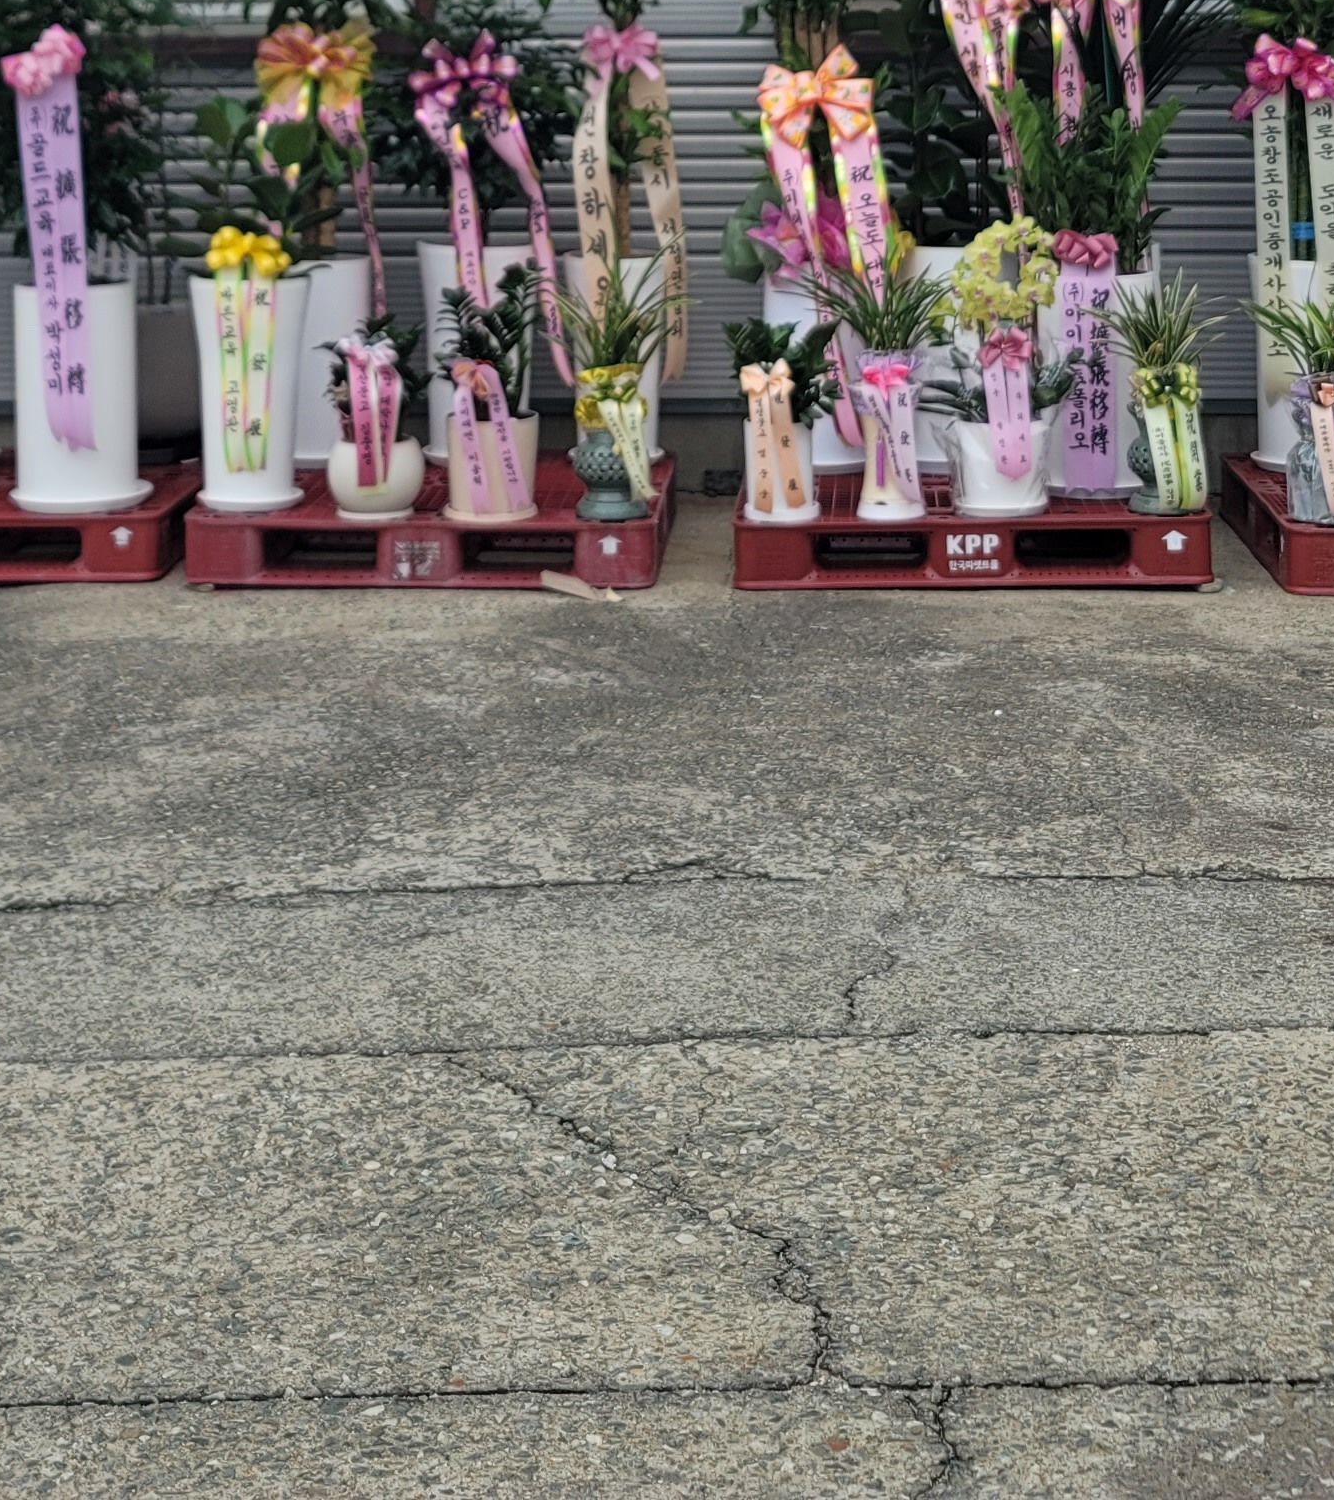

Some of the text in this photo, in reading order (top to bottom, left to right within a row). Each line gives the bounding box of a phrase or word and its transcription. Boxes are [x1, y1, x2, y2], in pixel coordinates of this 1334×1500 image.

[849, 164, 874, 184] 祝
[854, 192, 884, 245] 오늘도
[1258, 104, 1290, 358] 오송창조공인중개사사소
[1063, 281, 1089, 451] (주)아이트폴리오
[946, 533, 1000, 555] KPP
